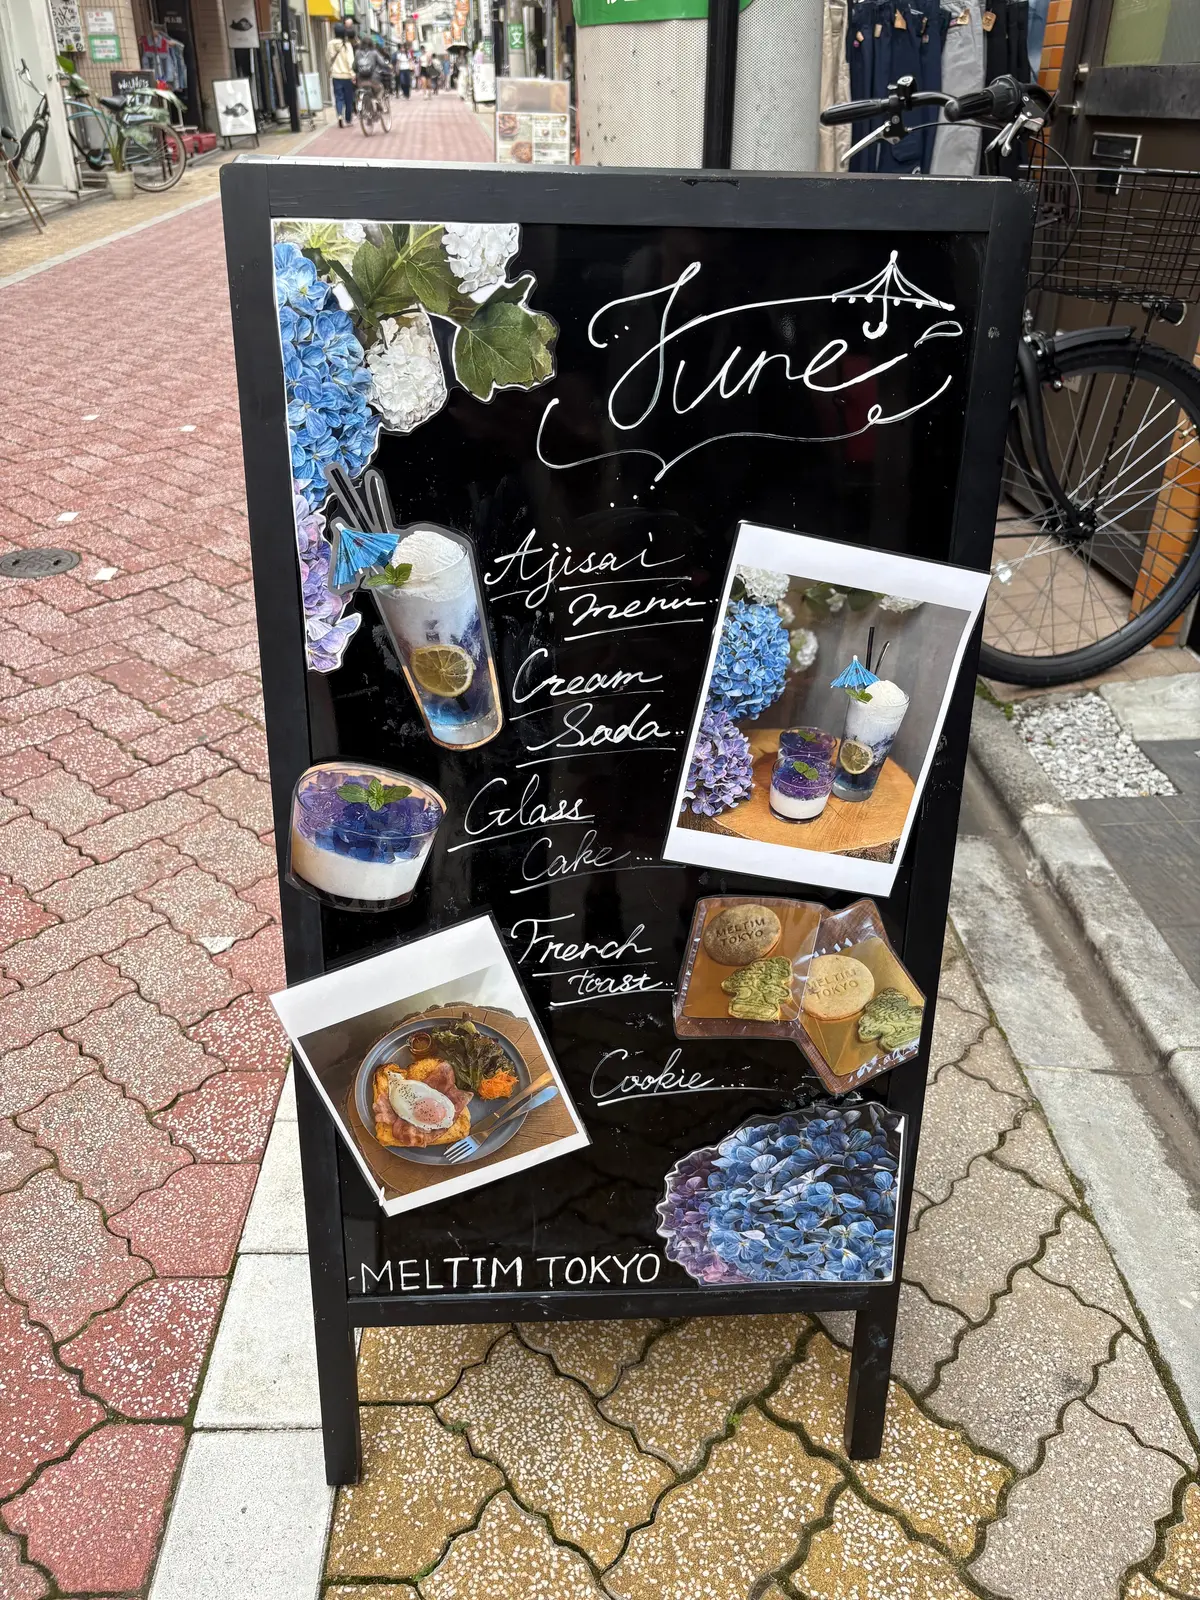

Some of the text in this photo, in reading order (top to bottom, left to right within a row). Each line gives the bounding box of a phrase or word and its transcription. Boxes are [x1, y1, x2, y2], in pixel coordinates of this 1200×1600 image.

[588, 262, 908, 430] June
[484, 528, 686, 608] Ajisai
[512, 648, 663, 703] Cream
[464, 774, 595, 835] Glass
[510, 913, 653, 964] French
[720, 929, 764, 946] TOKYO
[813, 979, 859, 999] TOKYO
[360, 1253, 660, 1293] MELTIM TOKYO
